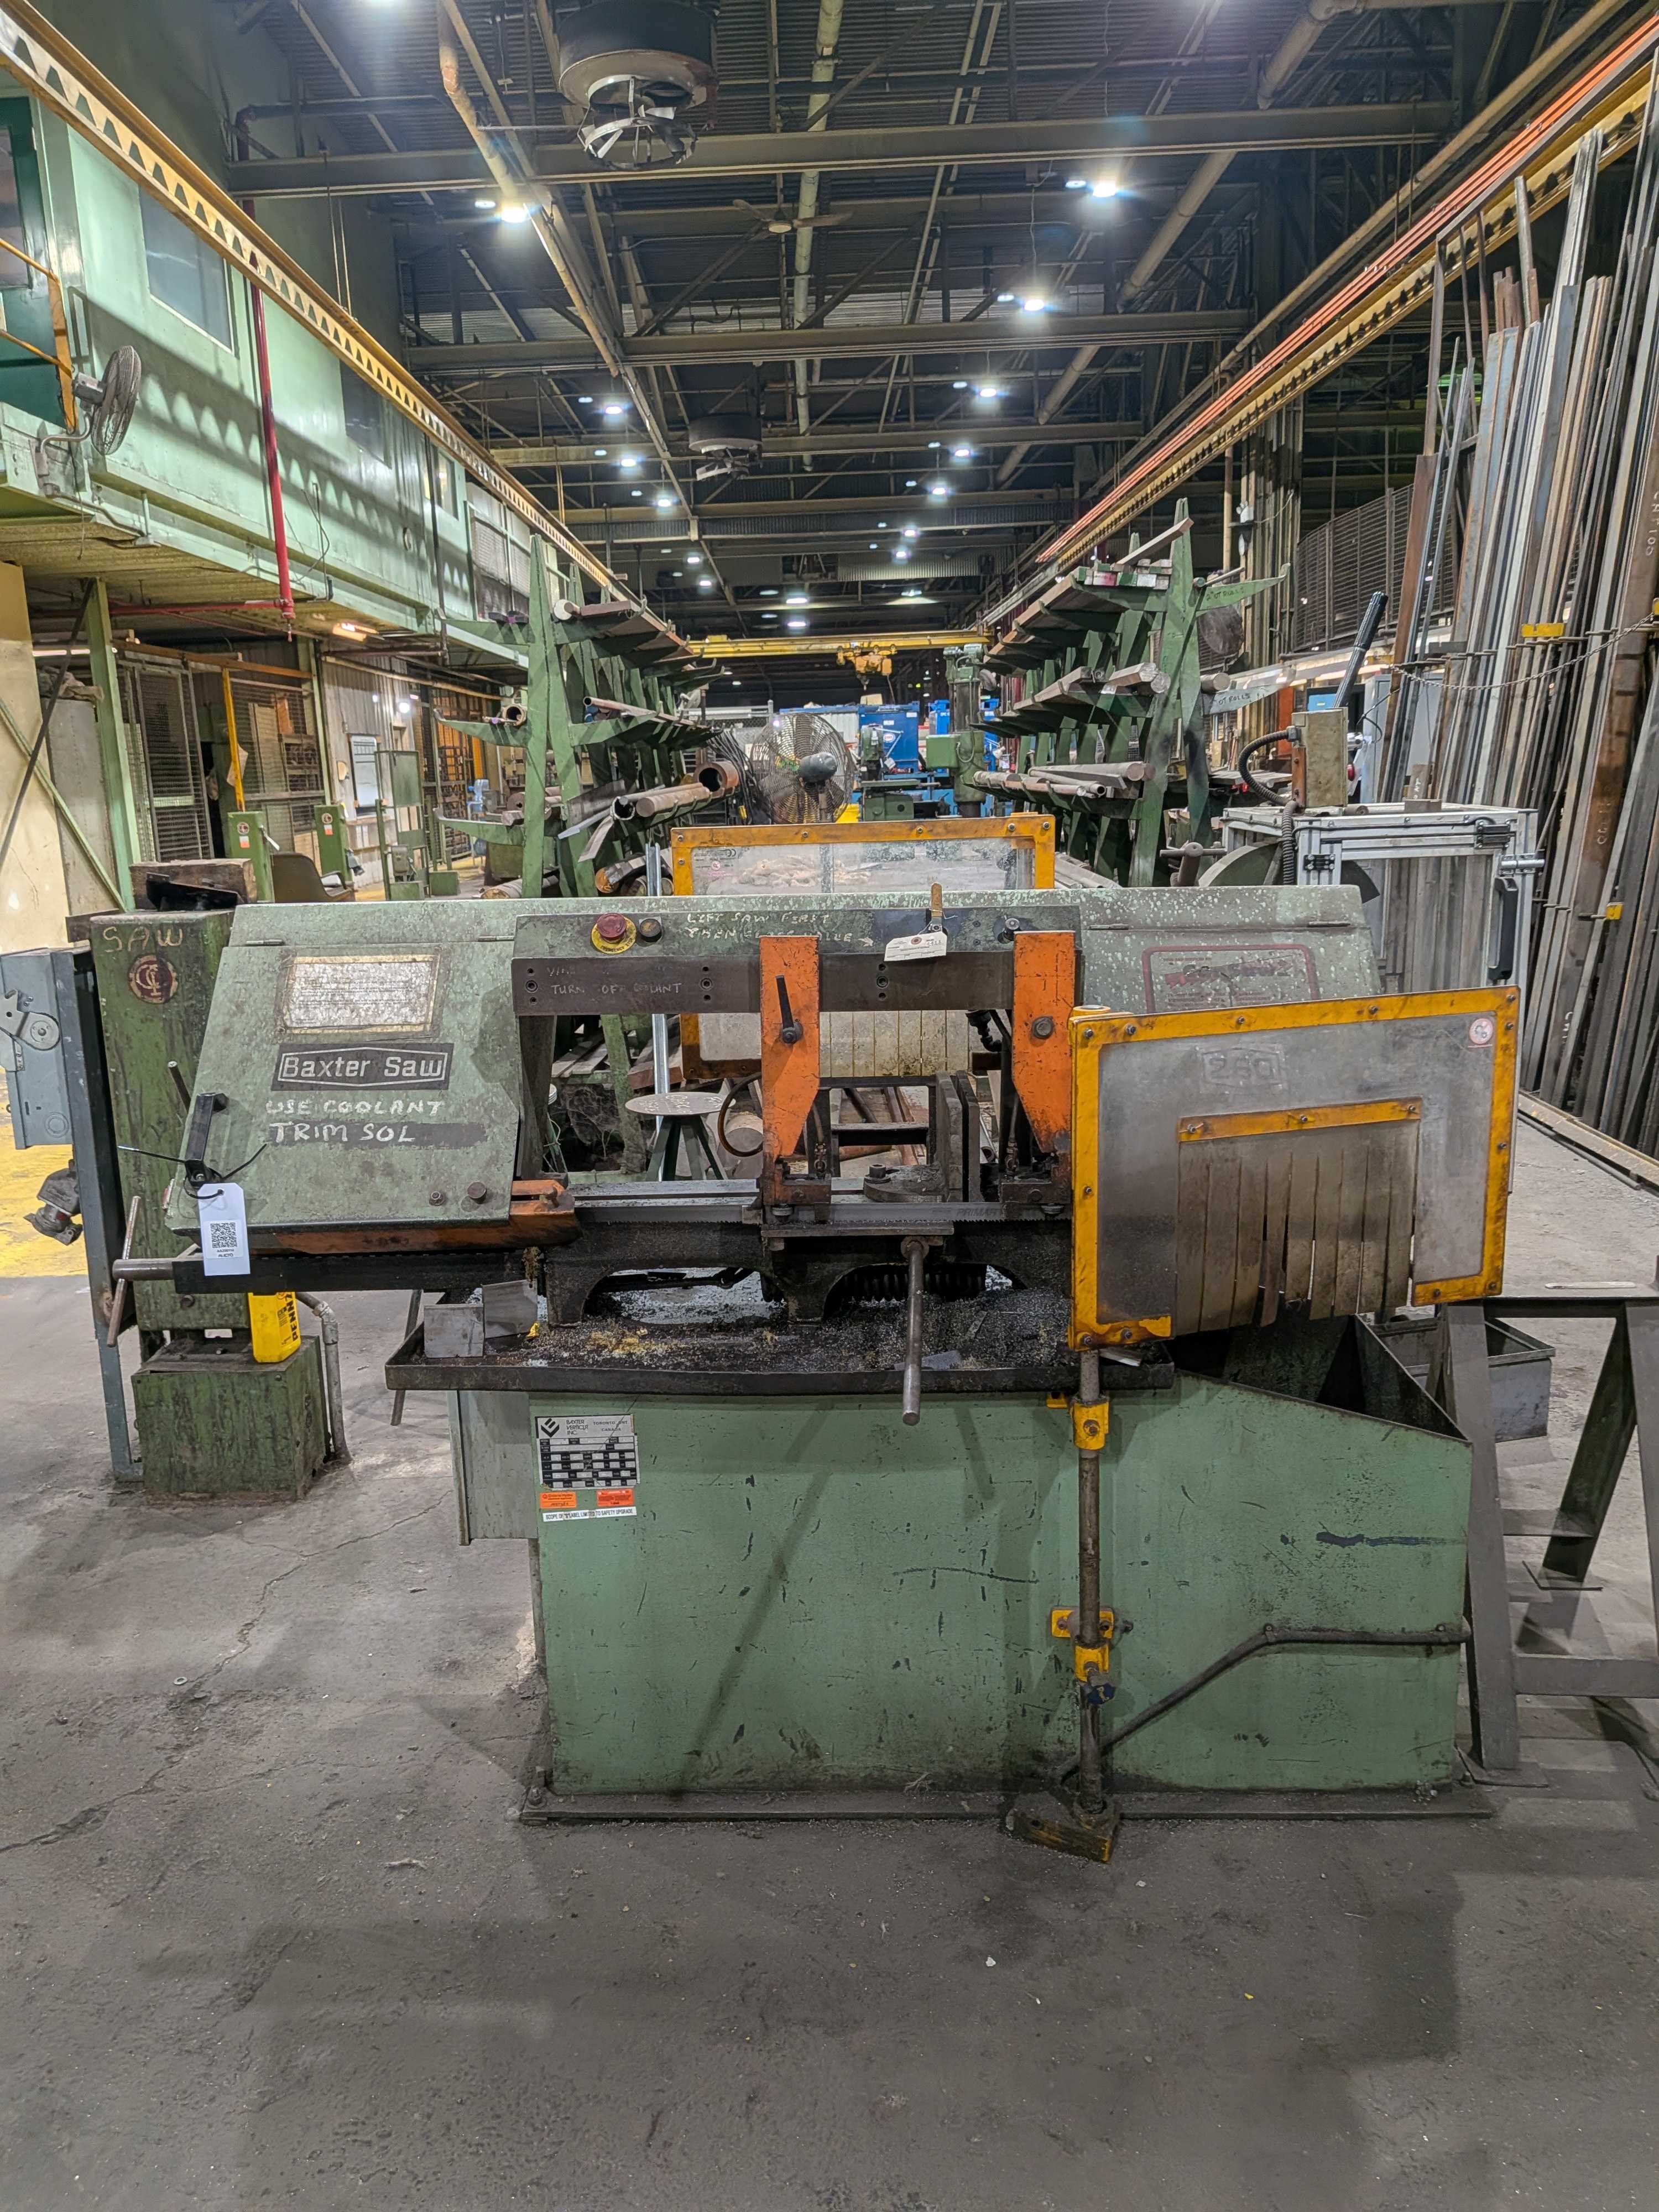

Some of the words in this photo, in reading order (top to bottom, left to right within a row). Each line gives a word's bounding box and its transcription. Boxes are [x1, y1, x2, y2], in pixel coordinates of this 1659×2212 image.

[1229, 693, 1250, 703] ROLLS
[687, 914, 724, 924] LIFT
[731, 913, 770, 924] SAW
[781, 912, 830, 924] FIRST
[102, 926, 183, 953] SAW
[551, 984, 585, 994] TURN
[282, 1056, 371, 1078] Baxter
[384, 1056, 443, 1077] Saw
[265, 1099, 312, 1115] USE
[322, 1099, 445, 1117] COOLANT
[269, 1120, 348, 1144] TRIM
[359, 1123, 416, 1143] SOL
[284, 1292, 299, 1342] PENNZ
